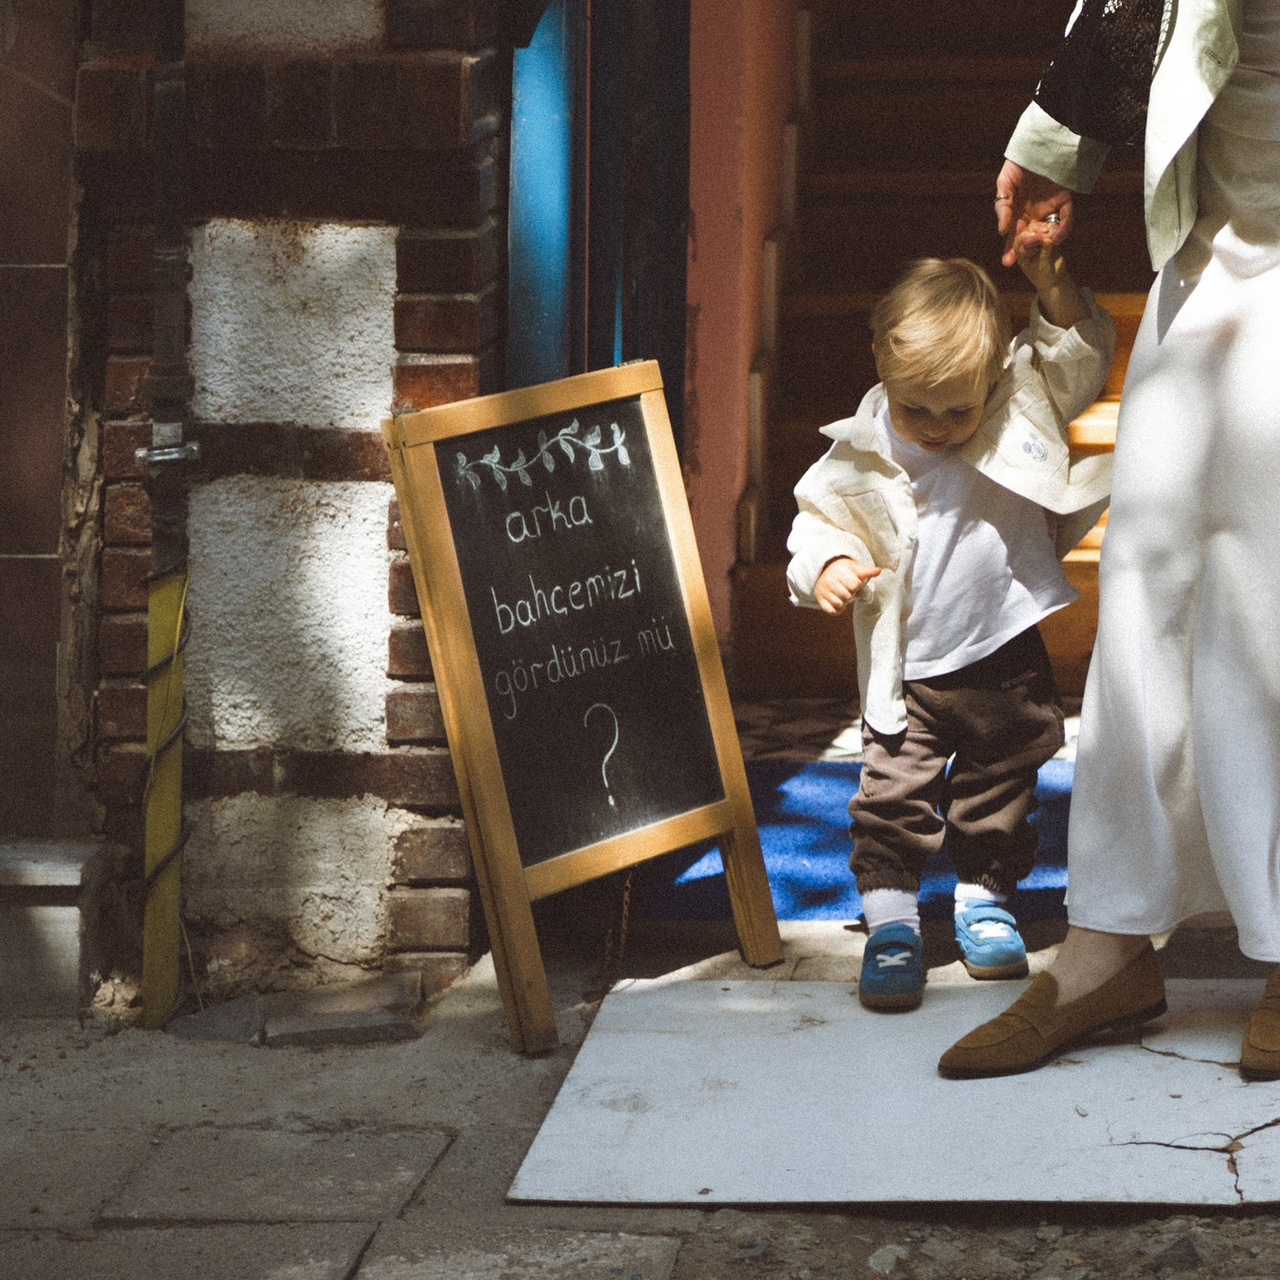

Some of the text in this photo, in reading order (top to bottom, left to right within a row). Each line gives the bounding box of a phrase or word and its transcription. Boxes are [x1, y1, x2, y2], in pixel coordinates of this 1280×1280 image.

[505, 490, 594, 543] arka
[491, 558, 642, 635] bahçemizi
[495, 616, 676, 720] gördünüz mü
